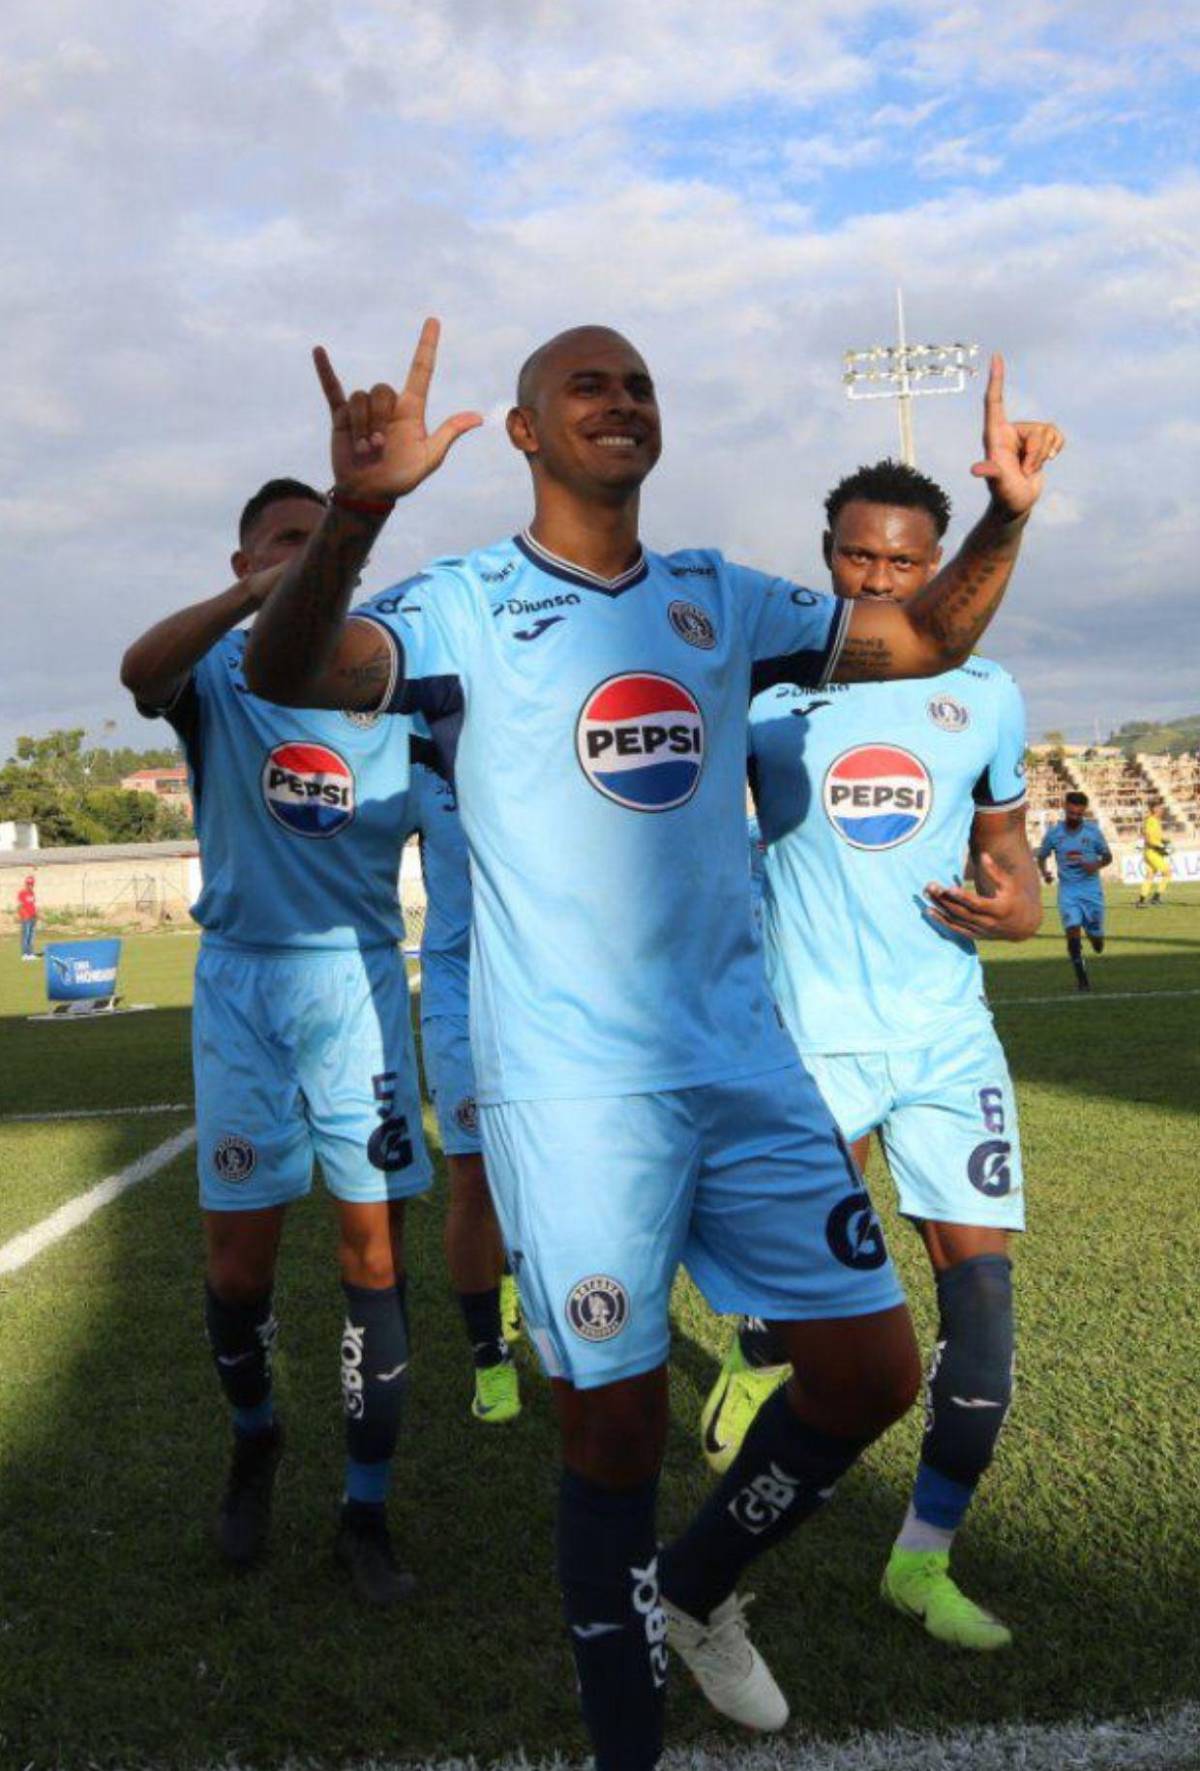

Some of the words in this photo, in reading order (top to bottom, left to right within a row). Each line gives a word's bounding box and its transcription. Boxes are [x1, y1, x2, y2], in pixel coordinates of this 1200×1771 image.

[506, 593, 582, 615] Diunsa
[586, 727, 700, 758] PEPSI
[269, 769, 349, 805] PEPSI
[830, 785, 925, 809] PEPSI
[967, 1139, 1011, 1198] G
[826, 1192, 888, 1270] G
